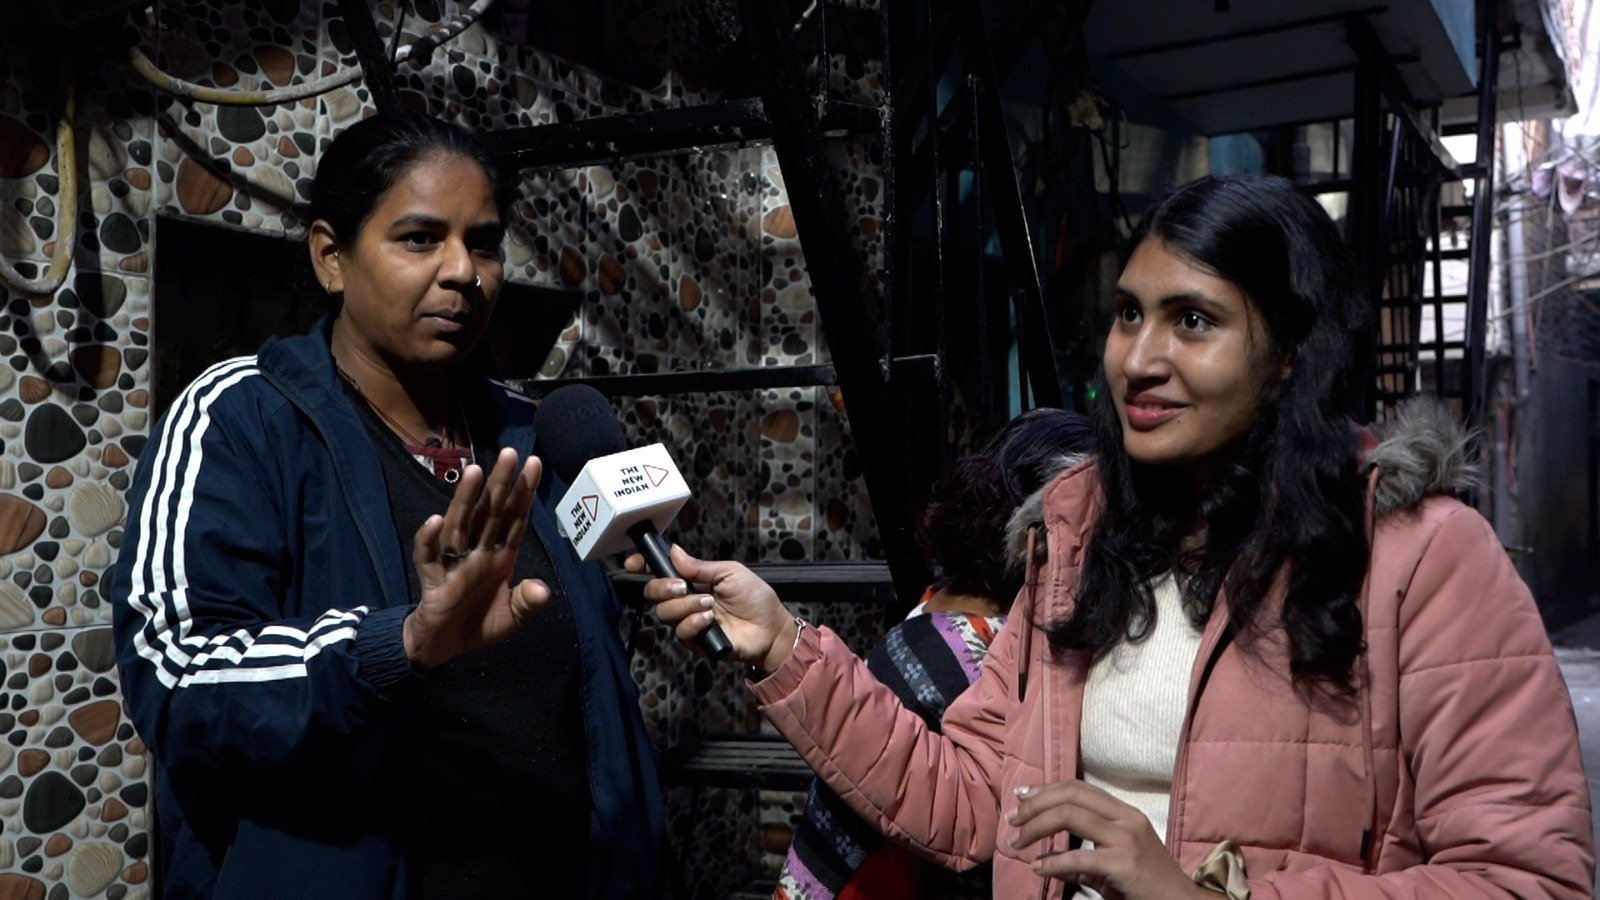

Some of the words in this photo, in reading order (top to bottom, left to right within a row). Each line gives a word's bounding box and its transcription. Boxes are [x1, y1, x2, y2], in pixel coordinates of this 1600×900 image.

[620, 466, 639, 476] THE
[621, 475, 644, 485] NEW
[614, 483, 649, 498] INDIAN
[570, 501, 583, 518] THE
[573, 511, 587, 529] NEW
[572, 520, 592, 546] INDIAN
